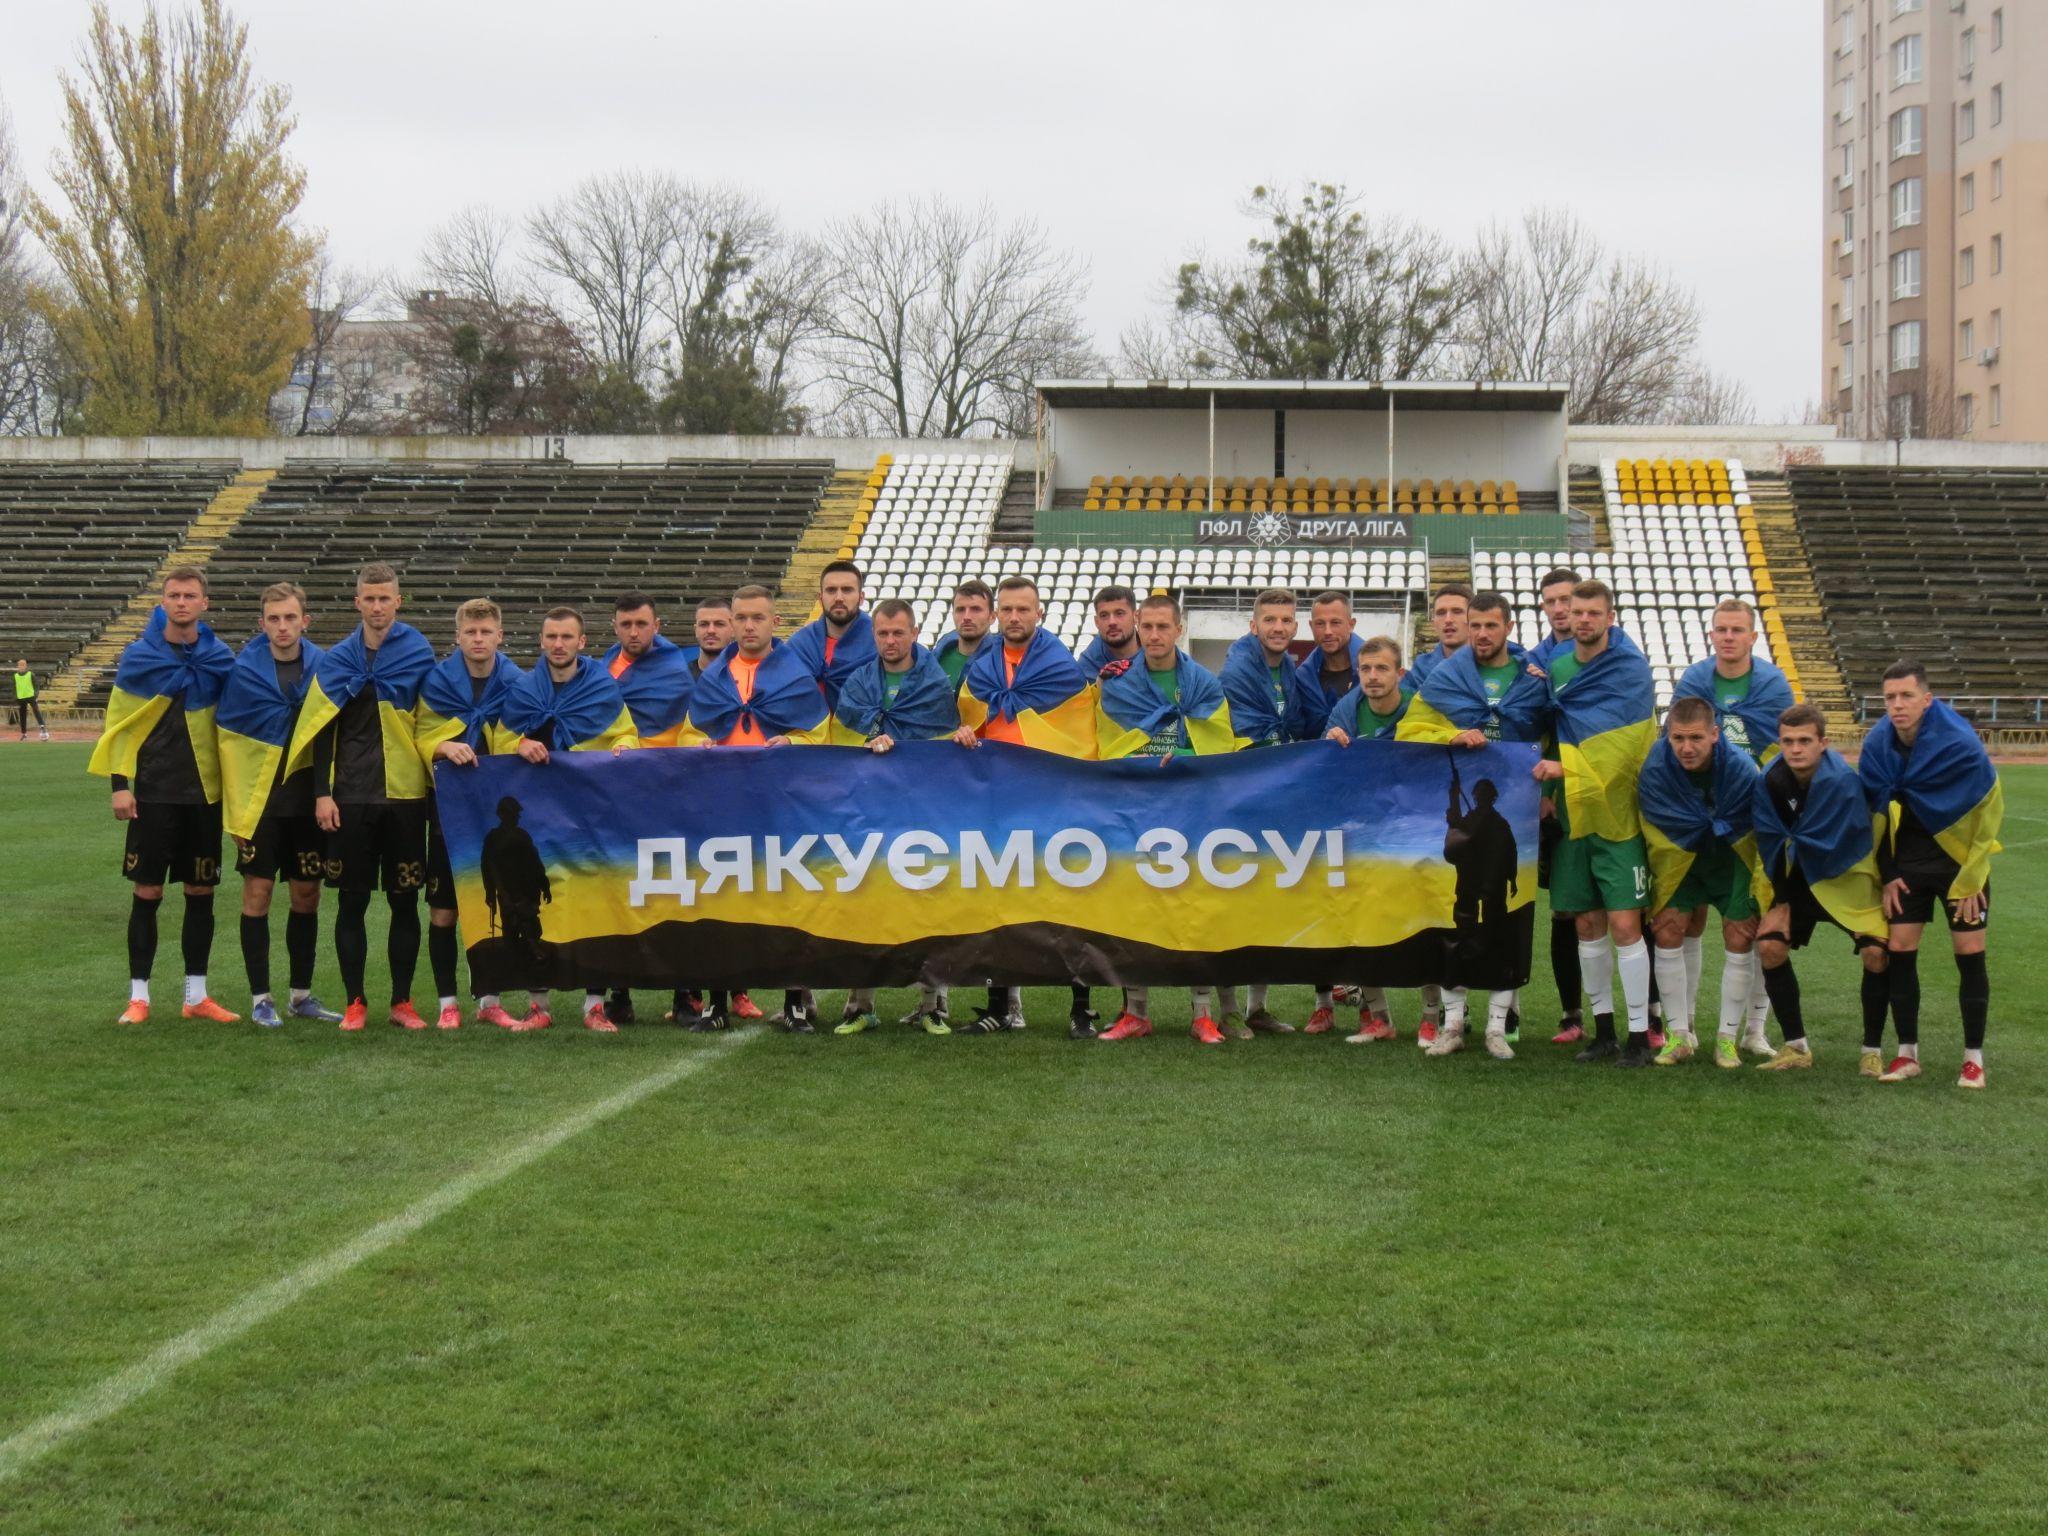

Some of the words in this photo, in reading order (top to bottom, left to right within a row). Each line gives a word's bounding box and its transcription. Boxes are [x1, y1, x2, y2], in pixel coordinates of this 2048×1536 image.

[545, 438, 565, 460] 13
[1200, 520, 1242, 536] ПФЛ
[1297, 520, 1359, 538] ДРУГА
[1359, 520, 1407, 536] ЛІГА
[195, 857, 215, 881] 10
[298, 851, 321, 875] 13
[398, 861, 422, 887] 33
[629, 828, 1108, 906] ДЯКУЄМО
[1135, 828, 1345, 888] ЗСУ!
